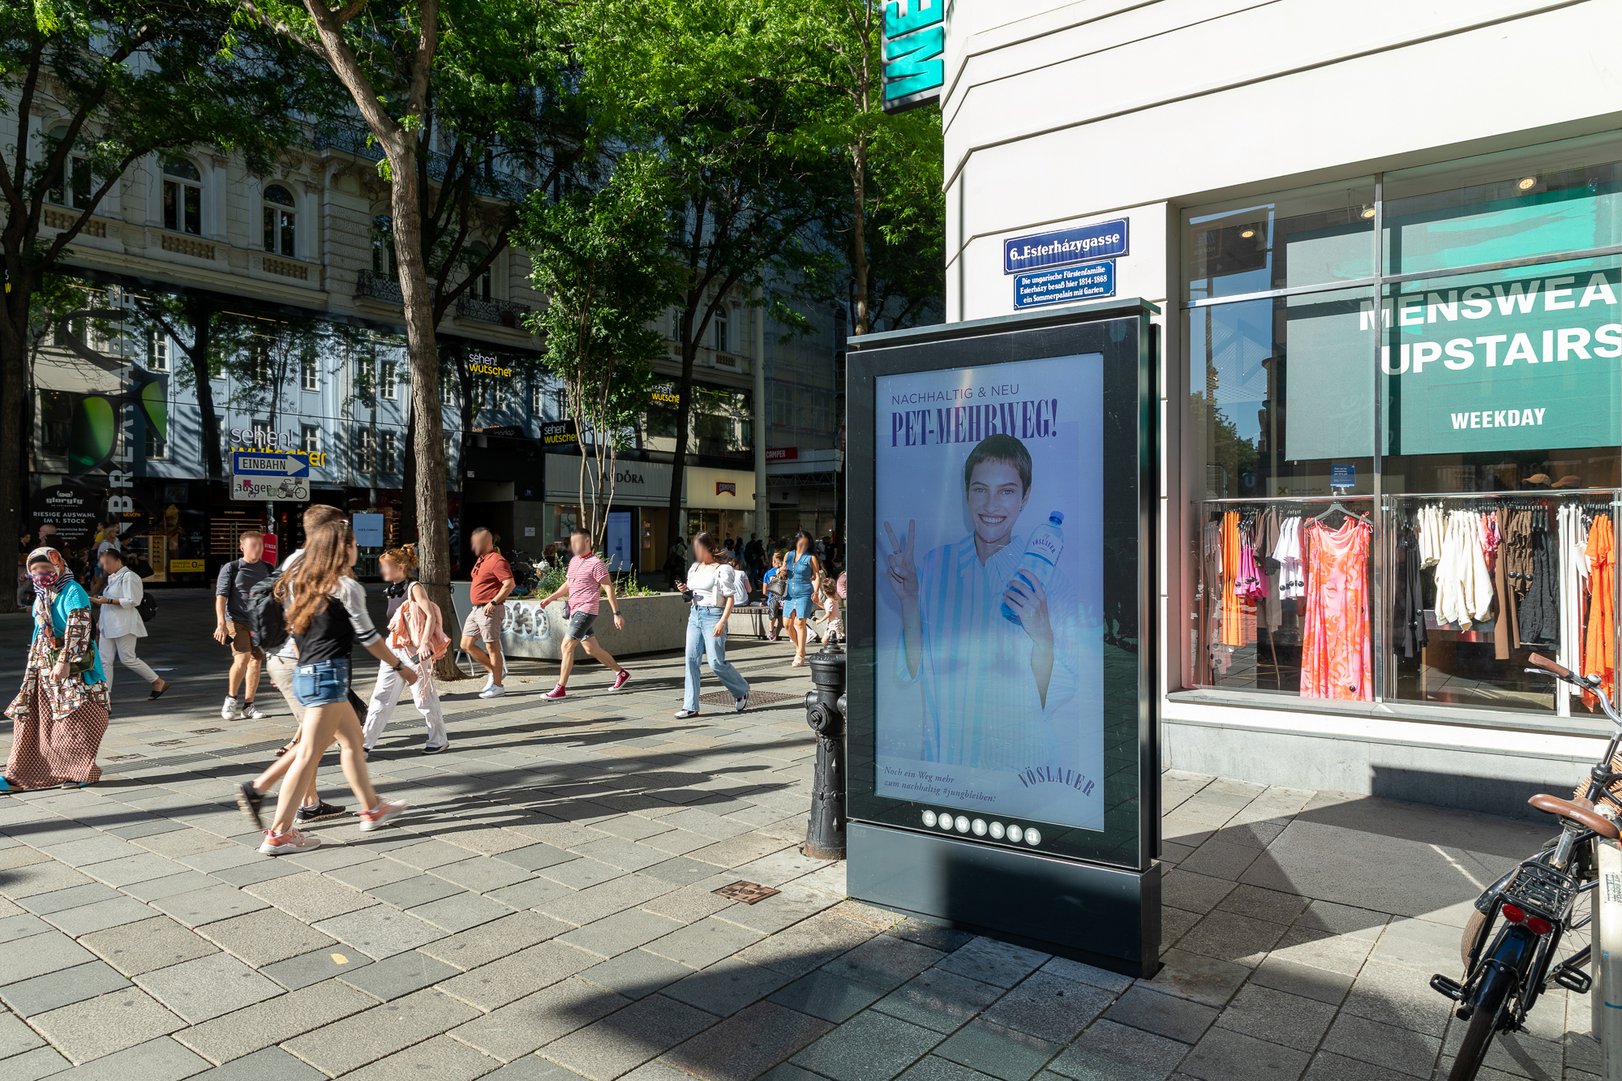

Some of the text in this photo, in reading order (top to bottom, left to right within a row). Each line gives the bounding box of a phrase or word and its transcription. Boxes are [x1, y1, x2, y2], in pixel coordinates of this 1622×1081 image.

[1023, 233, 1120, 259] Esterházygasse
[1022, 266, 1105, 285] Die ungarische Fürstenfamilie
[1020, 285, 1047, 295] Esterházy
[1048, 281, 1065, 290] besaß
[1066, 280, 1078, 288] hier
[1023, 286, 1104, 304] ein Sommerpalais mit Garten
[1381, 322, 1622, 375] UPSTAIRS
[469, 353, 498, 366] sehen!
[469, 363, 513, 377] wutscher
[891, 383, 1020, 405] NACHHALTIG & NEU
[891, 397, 1058, 448] PET-MEHRWEG!
[1450, 407, 1547, 430] WEEKDAY
[231, 425, 294, 447] sehen!
[543, 423, 567, 435] sehen!
[242, 458, 286, 470] EINBAHN
[884, 766, 902, 776] Noch
[918, 771, 933, 782] Weg
[935, 774, 955, 784] mehr
[1018, 766, 1095, 798] VÖSLAUER
[902, 782, 941, 796] nachhaltig
